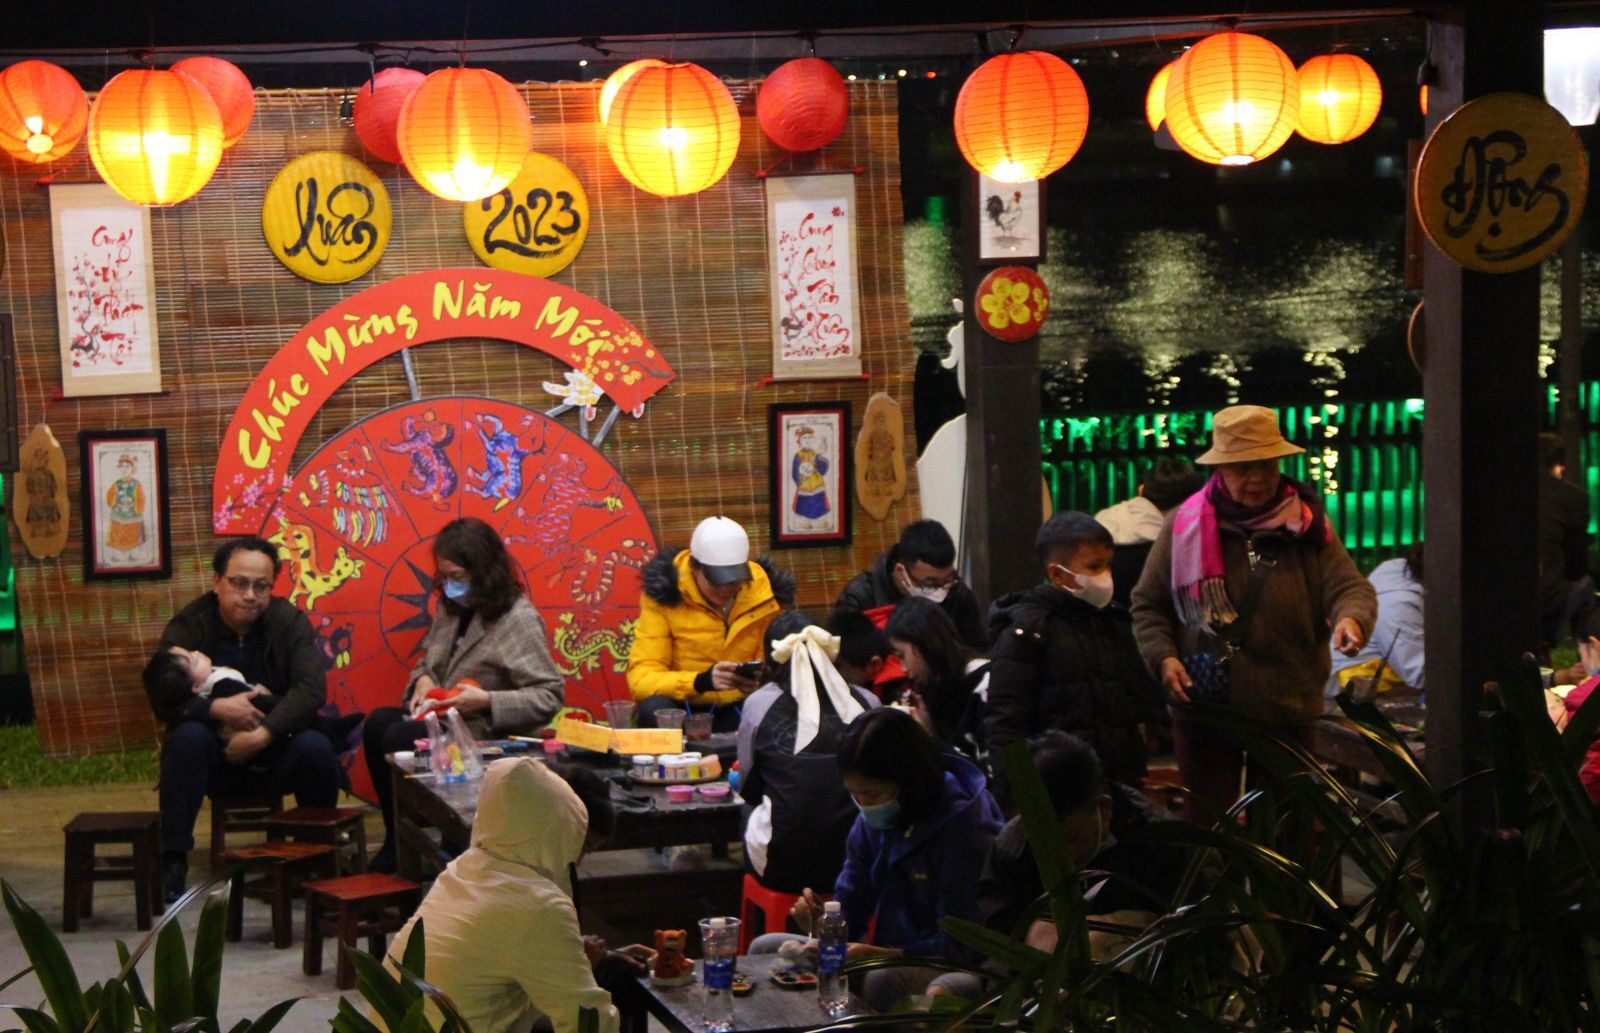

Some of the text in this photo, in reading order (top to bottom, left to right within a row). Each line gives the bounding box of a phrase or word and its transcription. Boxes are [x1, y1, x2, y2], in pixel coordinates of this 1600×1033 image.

[481, 187, 581, 258] 2023
[238, 280, 611, 470] Chúc Mừng Năm Mới
